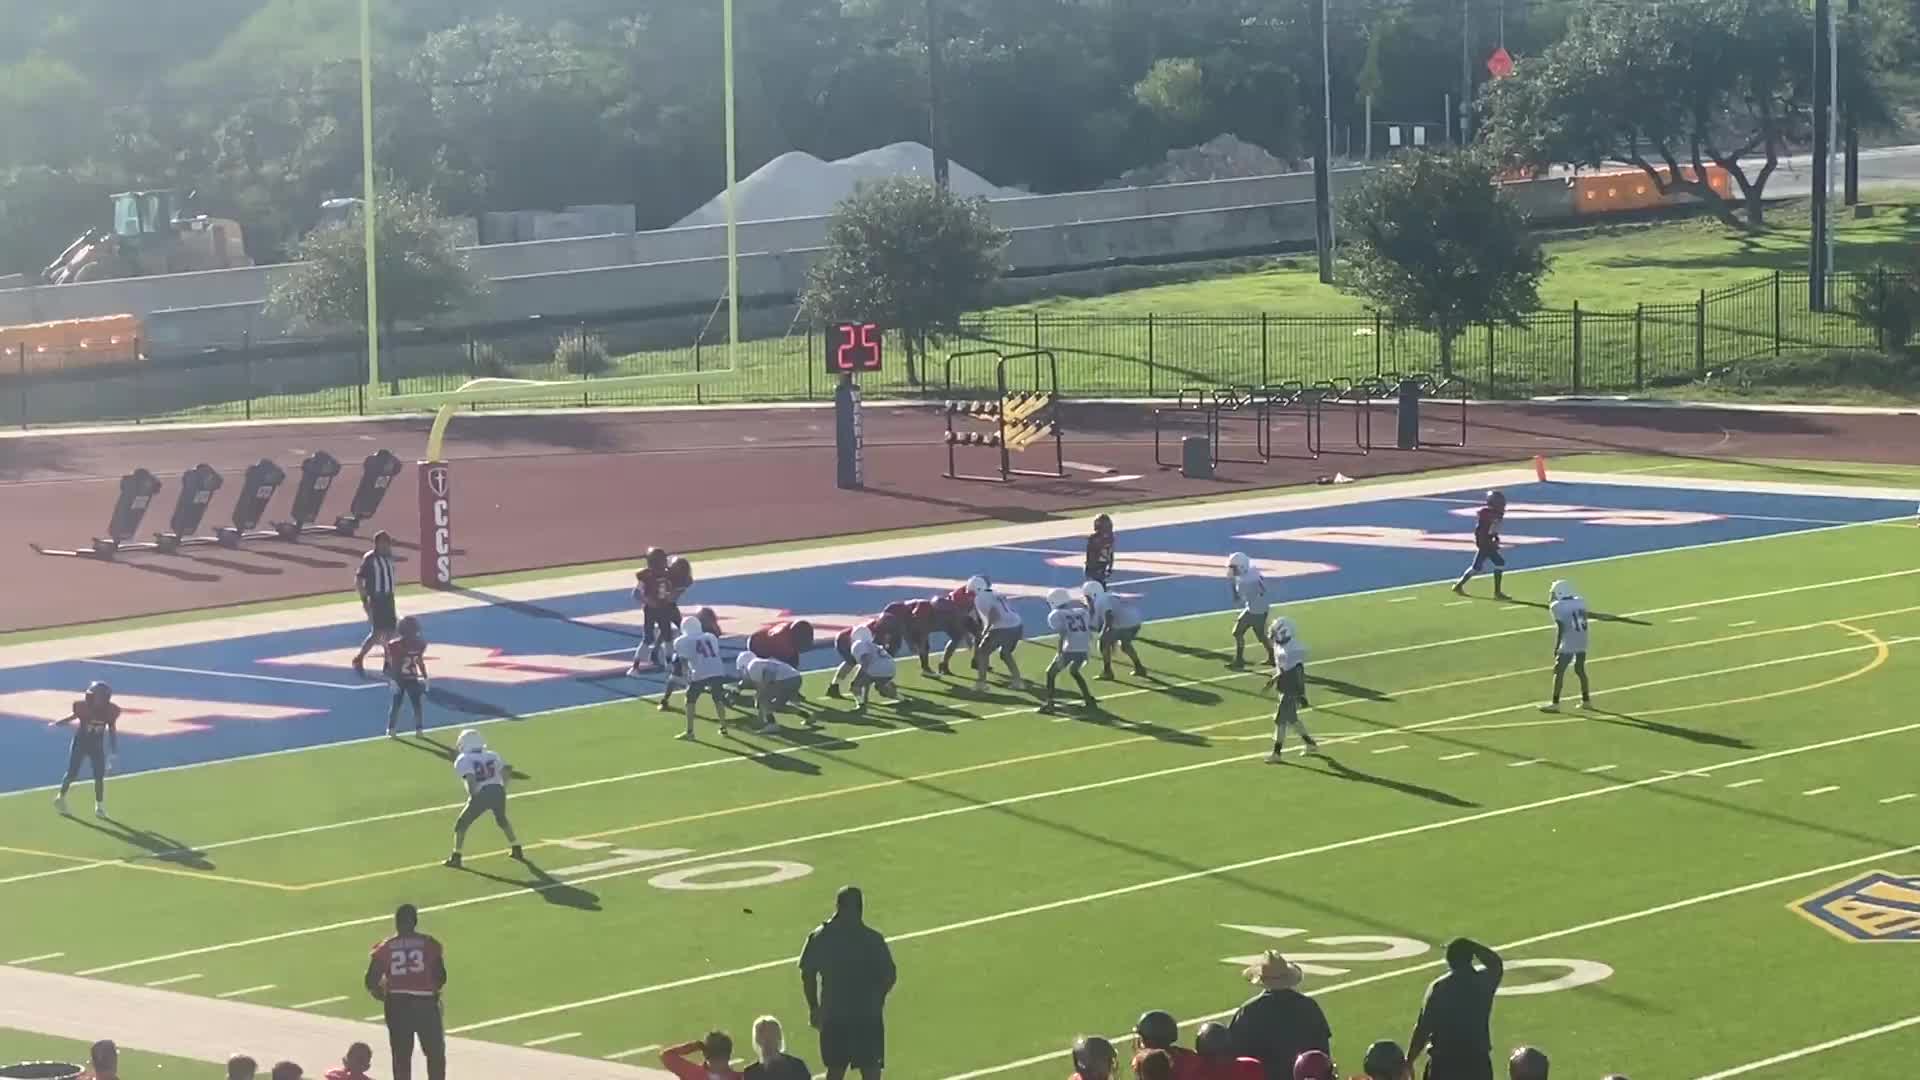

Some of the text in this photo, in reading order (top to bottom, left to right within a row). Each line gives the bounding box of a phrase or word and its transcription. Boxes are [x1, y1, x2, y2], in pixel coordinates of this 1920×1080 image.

[838, 324, 879, 368] 25
[434, 499, 449, 582] CCS
[391, 949, 424, 975] 23
